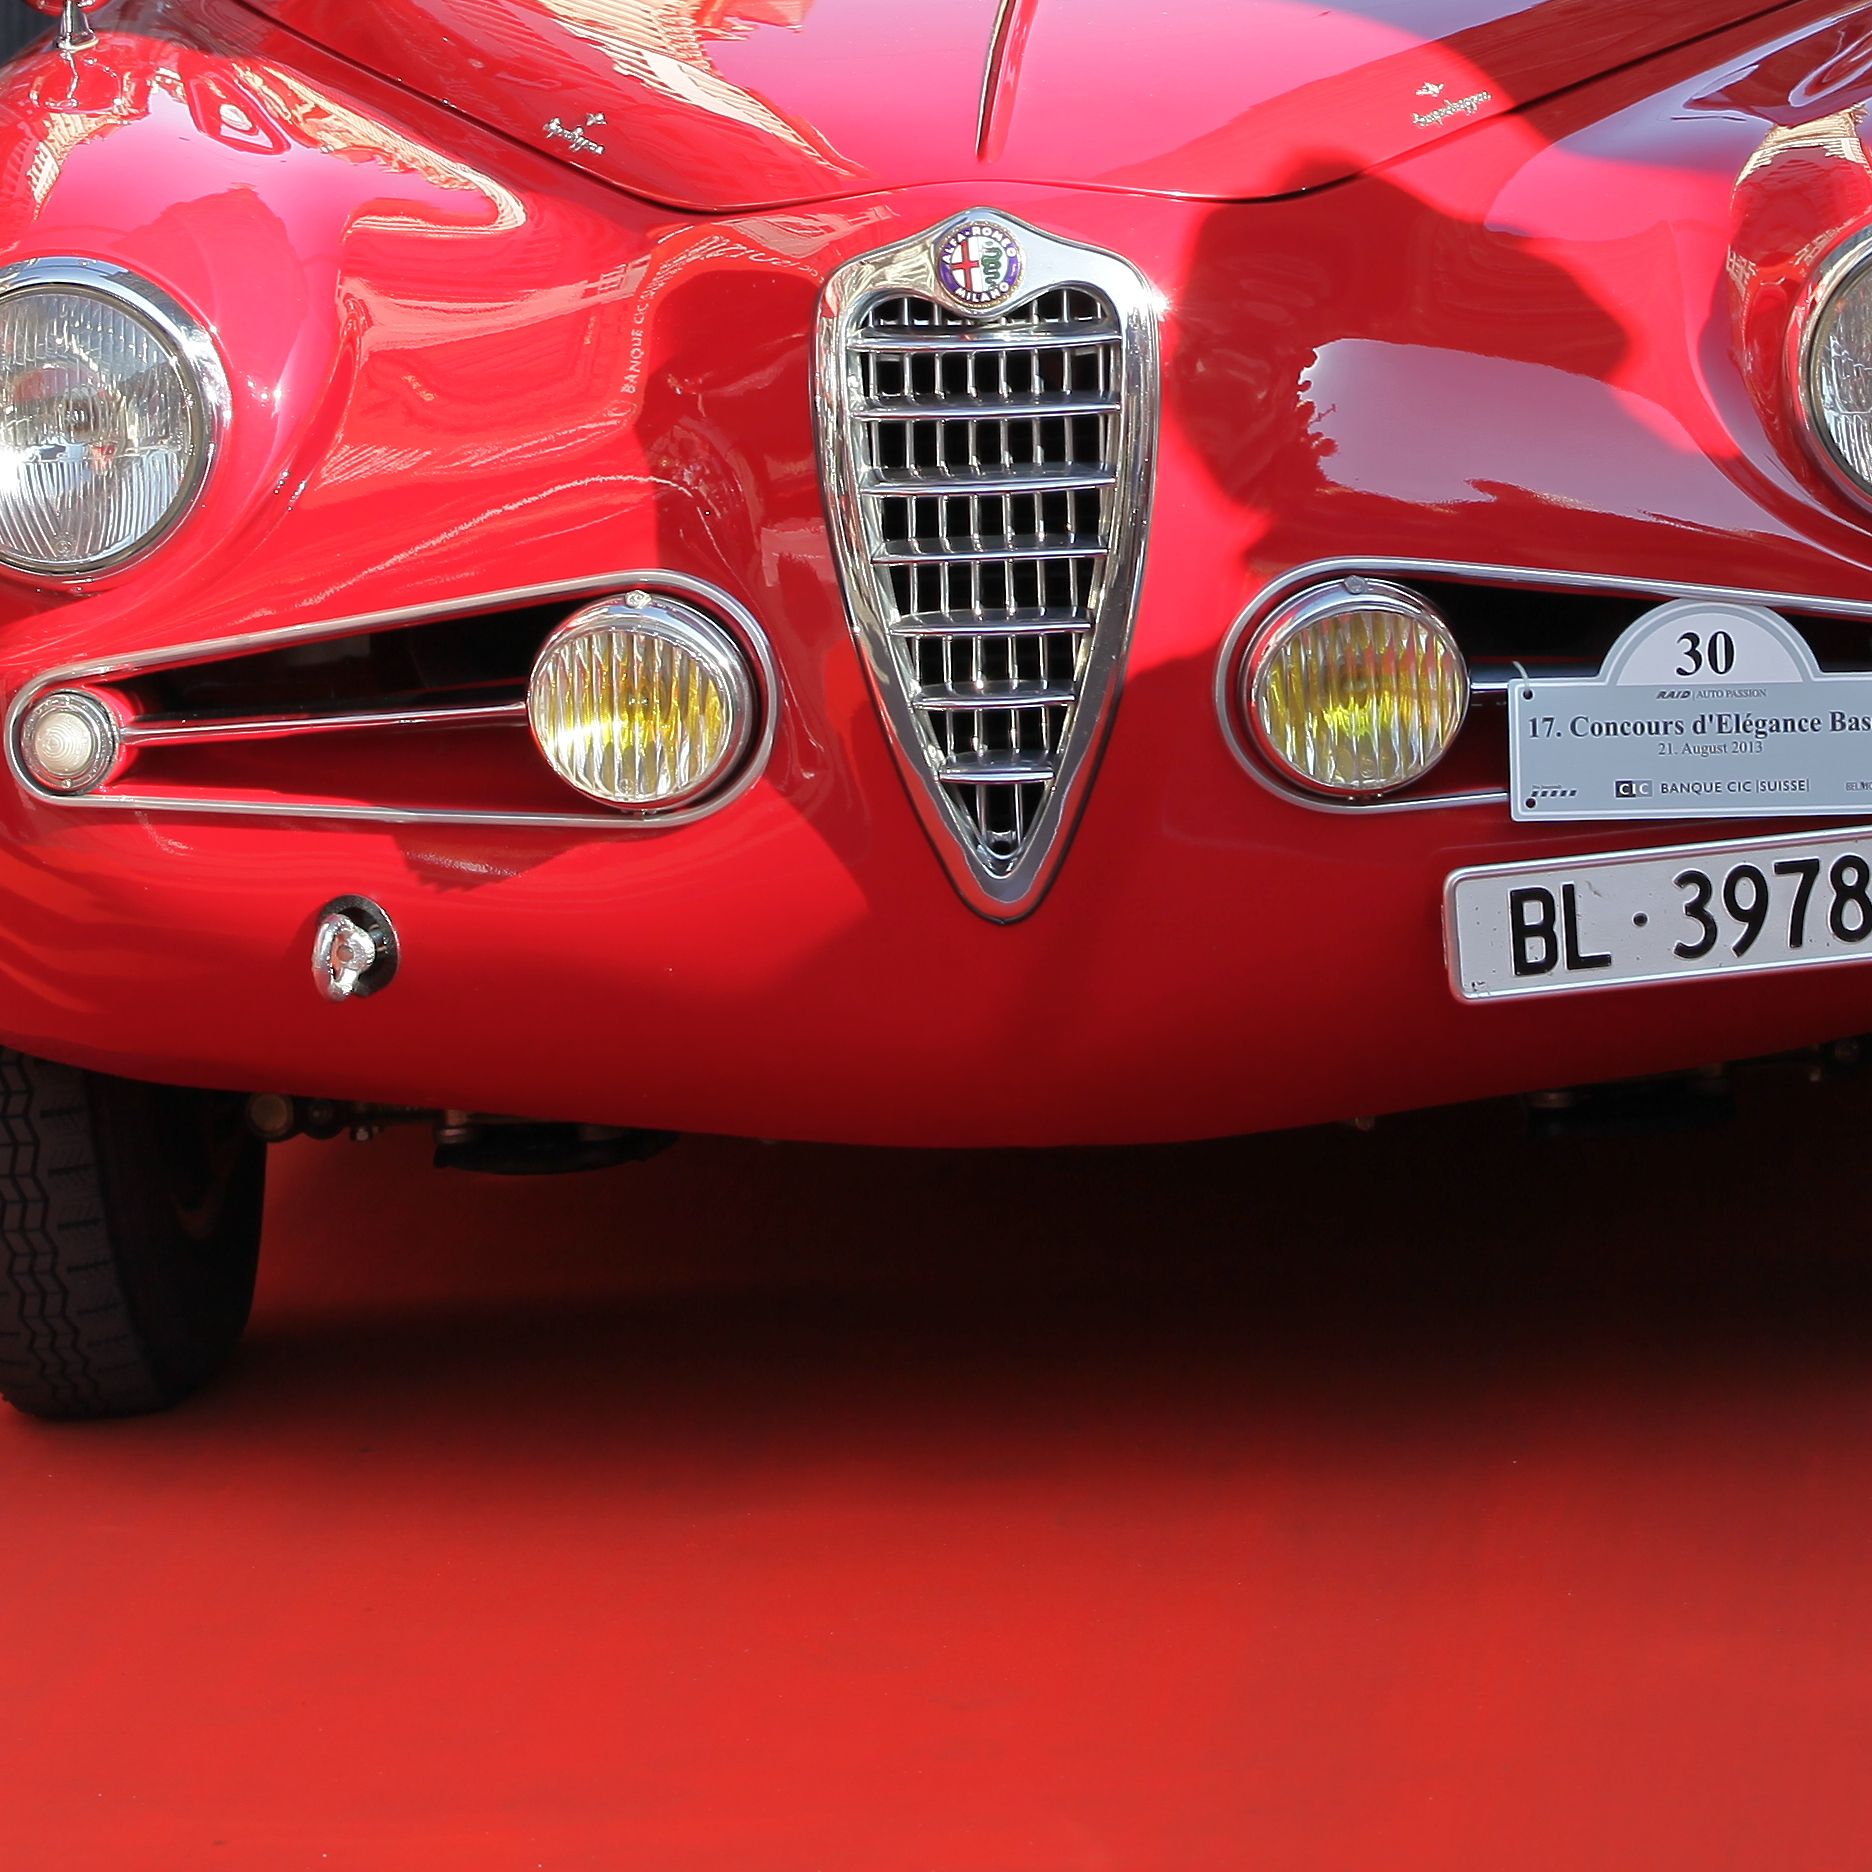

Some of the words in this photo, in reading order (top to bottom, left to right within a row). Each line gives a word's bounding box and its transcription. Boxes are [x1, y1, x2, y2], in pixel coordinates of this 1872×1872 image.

[954, 281, 1009, 303] MILANO
[1675, 631, 1735, 677] 30
[1656, 689, 1692, 700] RAID
[1696, 688, 1725, 699] AUTO
[1726, 687, 1767, 699] PASSION
[1529, 717, 1562, 738] 17.
[1570, 715, 1685, 737] Concours
[1692, 712, 1822, 739] d'Elégance
[1657, 742, 1678, 756] 21.
[1681, 742, 1728, 758] August
[1732, 740, 1764, 754] 2013
[1618, 782, 1650, 795] CIC
[1660, 781, 1723, 796] BANQUE
[1727, 781, 1752, 793] CIC
